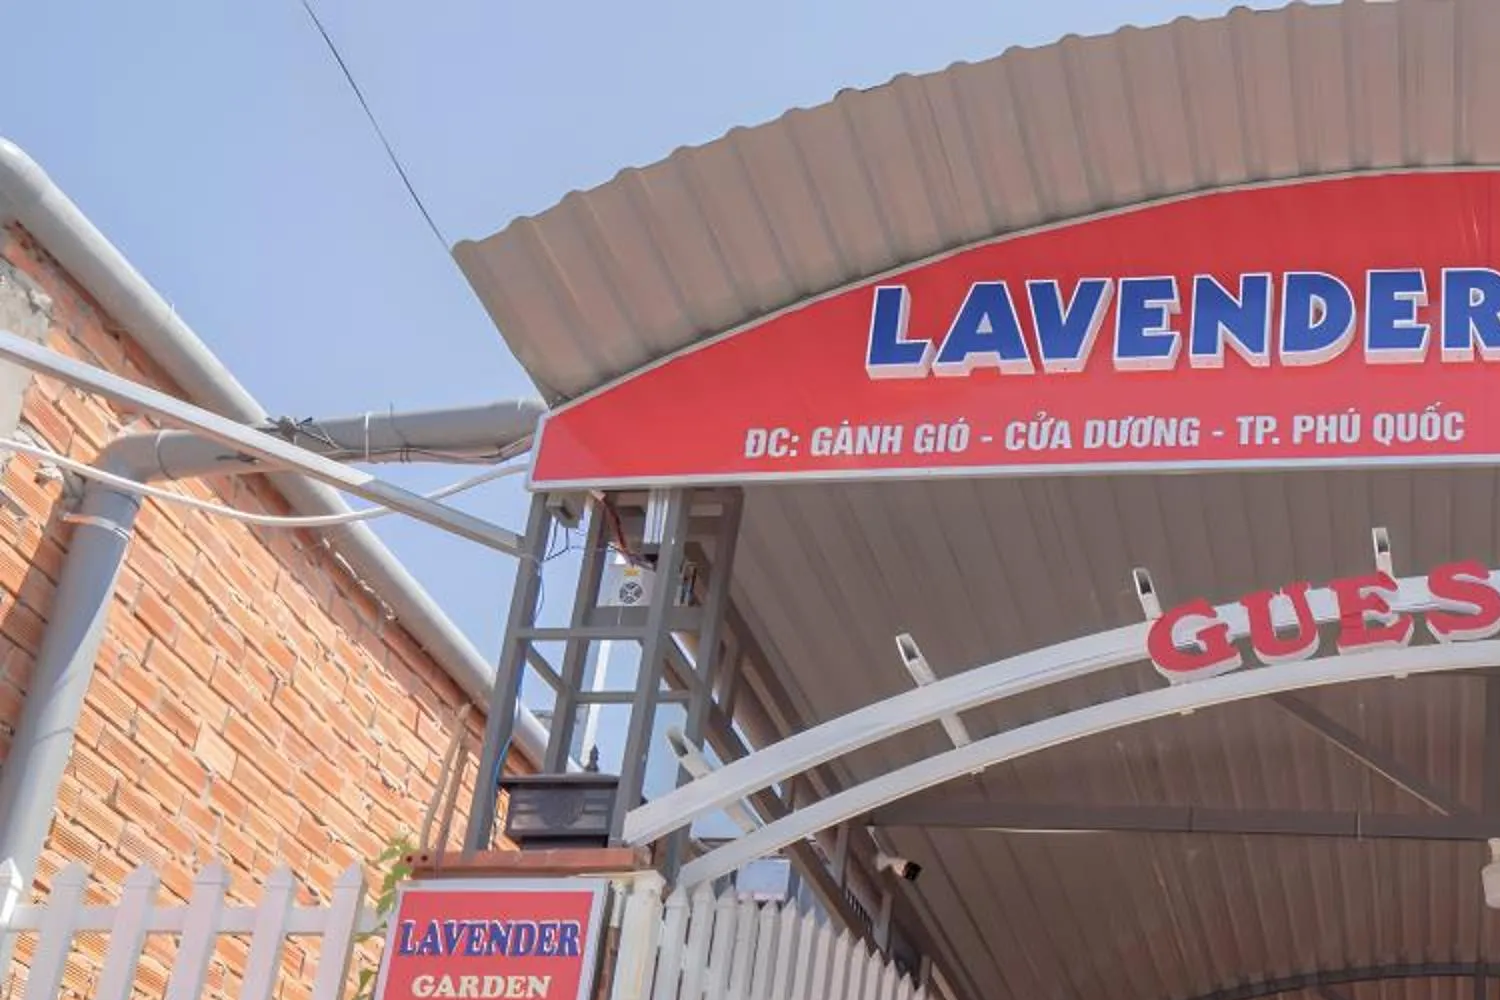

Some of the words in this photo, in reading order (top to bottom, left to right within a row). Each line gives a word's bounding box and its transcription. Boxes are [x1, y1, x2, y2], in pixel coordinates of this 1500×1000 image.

[744, 427, 800, 458] ĐC:
[912, 416, 970, 454] GIÓ
[1005, 410, 1073, 451] CỬA
[1083, 415, 1200, 449] DƯƠNG
[1236, 415, 1280, 446] TP.
[1292, 407, 1361, 444] PHÚ
[1372, 401, 1466, 446] QUỐC
[399, 919, 583, 957] LAVENDER
[411, 974, 552, 999] GARDEN
